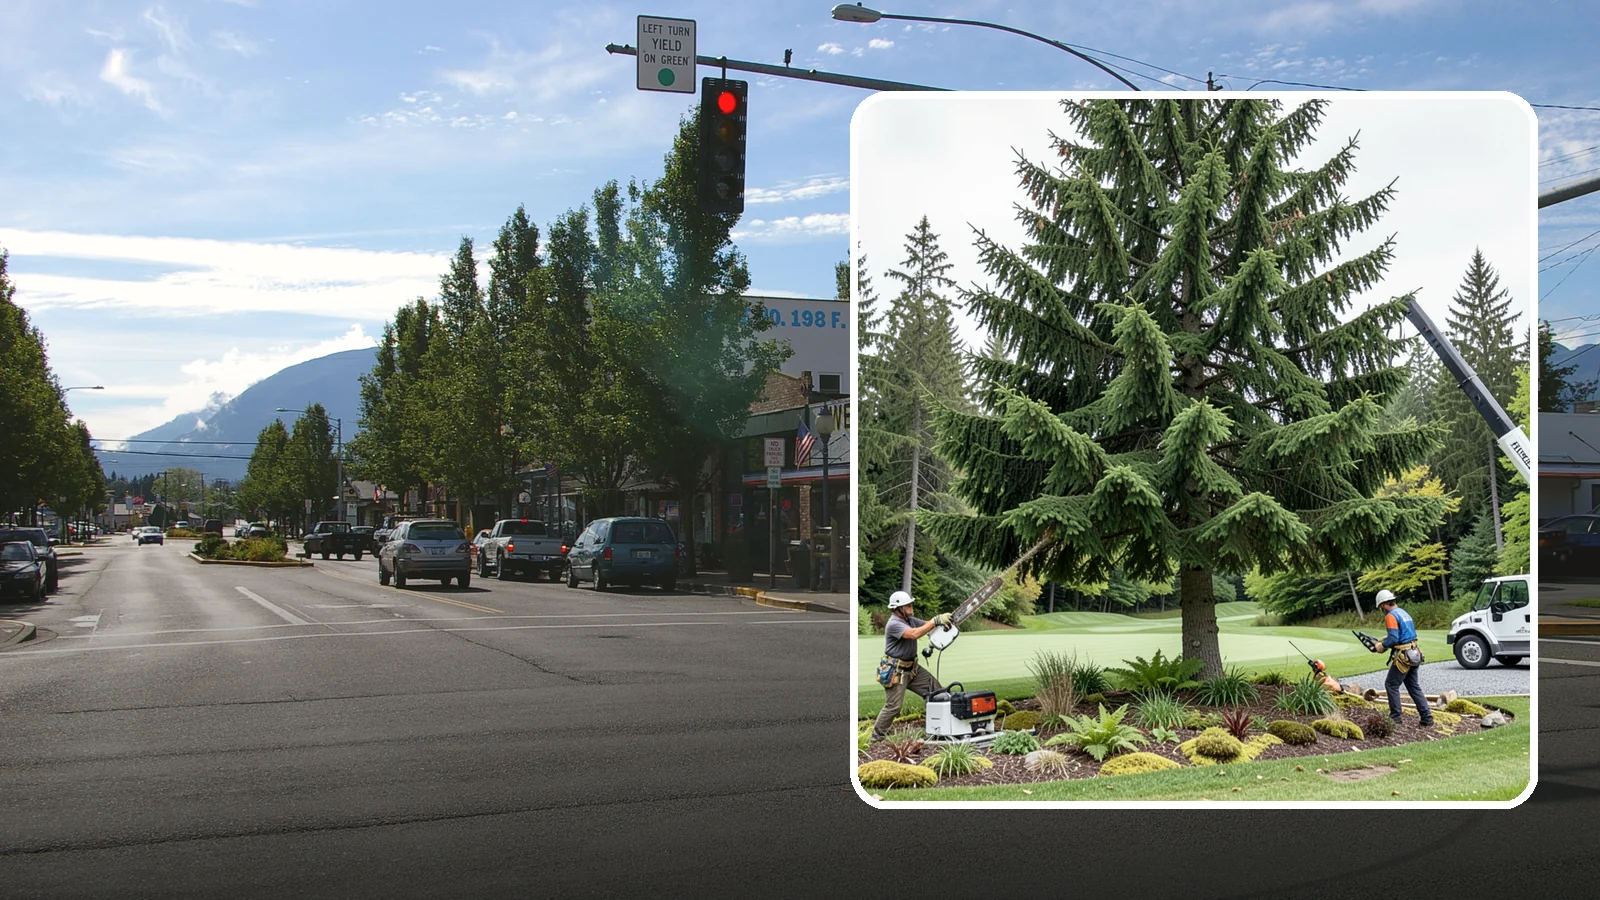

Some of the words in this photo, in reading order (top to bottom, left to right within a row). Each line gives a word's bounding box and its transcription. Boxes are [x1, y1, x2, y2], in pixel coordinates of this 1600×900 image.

[643, 23, 663, 34] LEFT
[668, 25, 690, 37] TURN
[652, 38, 682, 52] YIELD
[644, 53, 656, 64] ON
[661, 55, 689, 66] GREEN
[791, 309, 826, 329] 198
[831, 311, 847, 329] F.
